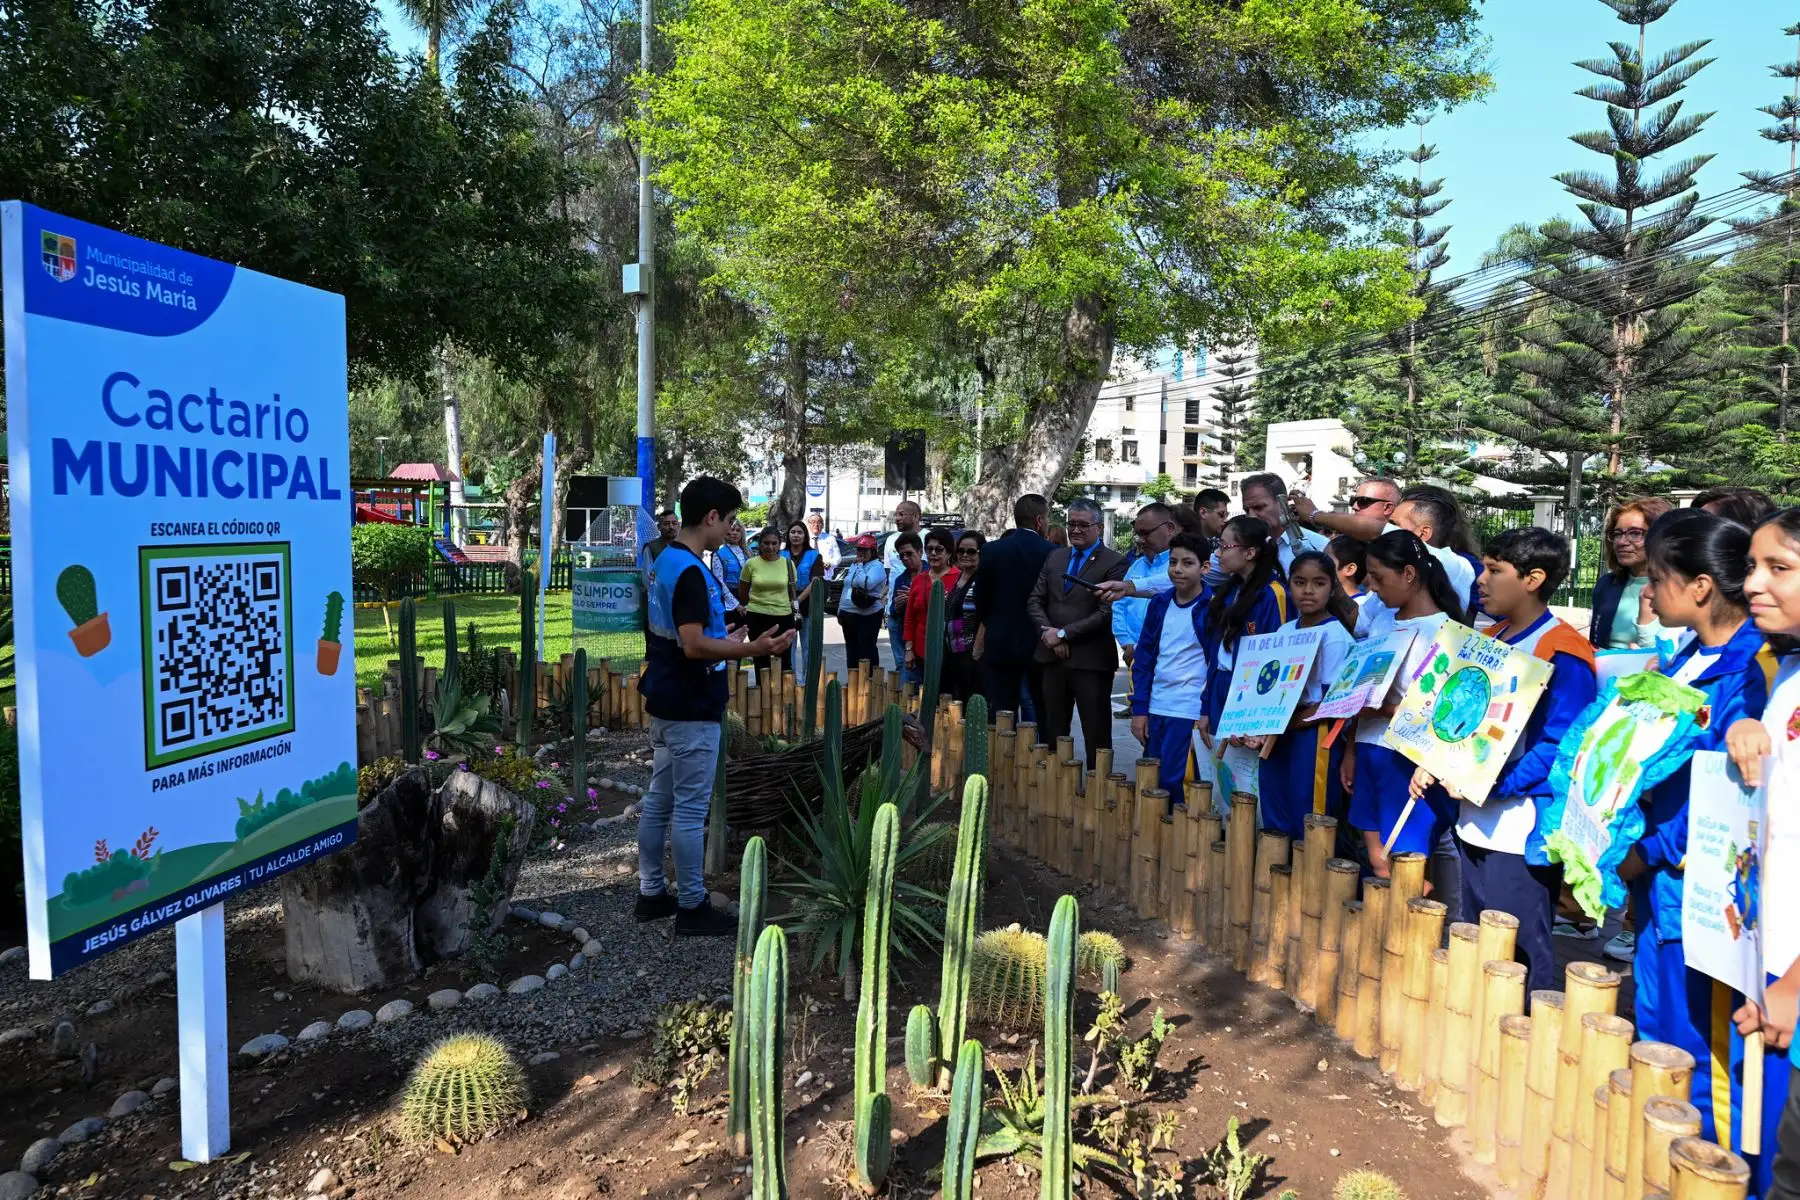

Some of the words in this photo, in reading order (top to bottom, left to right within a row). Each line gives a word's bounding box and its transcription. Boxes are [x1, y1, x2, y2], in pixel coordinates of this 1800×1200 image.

[86, 245, 176, 283] Municipalidad
[178, 271, 195, 287] de
[84, 265, 141, 298] Jesús
[146, 280, 198, 312] María
[102, 371, 310, 443] Cactario
[52, 437, 342, 501] MUNICIPAL
[151, 522, 206, 537] ESCANEA
[208, 522, 220, 536] EL
[221, 518, 265, 536] CÓDIGO
[266, 521, 281, 537] QR
[584, 586, 633, 599] LIMPIOS
[586, 601, 618, 610] SIEMPRE
[1258, 637, 1272, 652] DE
[1273, 635, 1285, 649] LA
[1288, 631, 1318, 648] TIERRA
[1463, 633, 1481, 653] 22
[152, 771, 185, 792] PARA
[188, 760, 214, 783] MÁS
[217, 740, 292, 774] INFORMACIÓN
[82, 925, 128, 954] JESÚS
[130, 901, 183, 932] GÁLVEZ
[184, 875, 242, 909] OLIVARES
[249, 868, 264, 882] TU
[266, 848, 312, 875] ALCALDE
[313, 832, 343, 854] AMIGO
